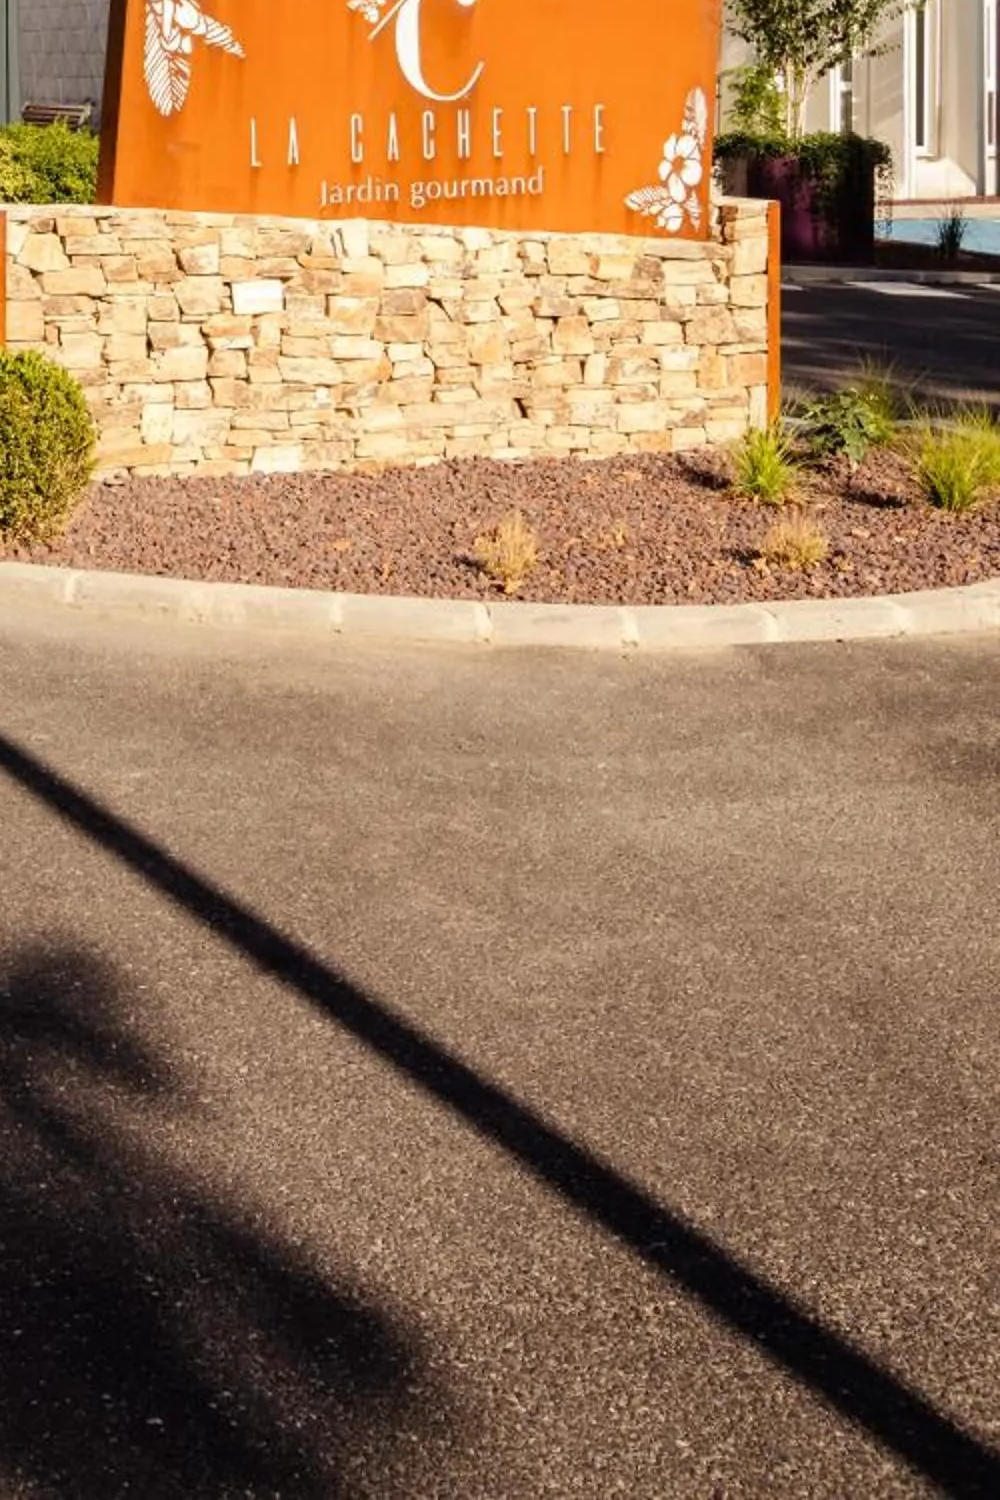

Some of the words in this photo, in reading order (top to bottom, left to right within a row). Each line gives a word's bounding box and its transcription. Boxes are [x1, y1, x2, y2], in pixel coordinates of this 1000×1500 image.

[250, 117, 300, 167] LA
[350, 104, 605, 163] CACHETTE
[319, 174, 400, 207] Jardin
[410, 166, 545, 208] gourmand
